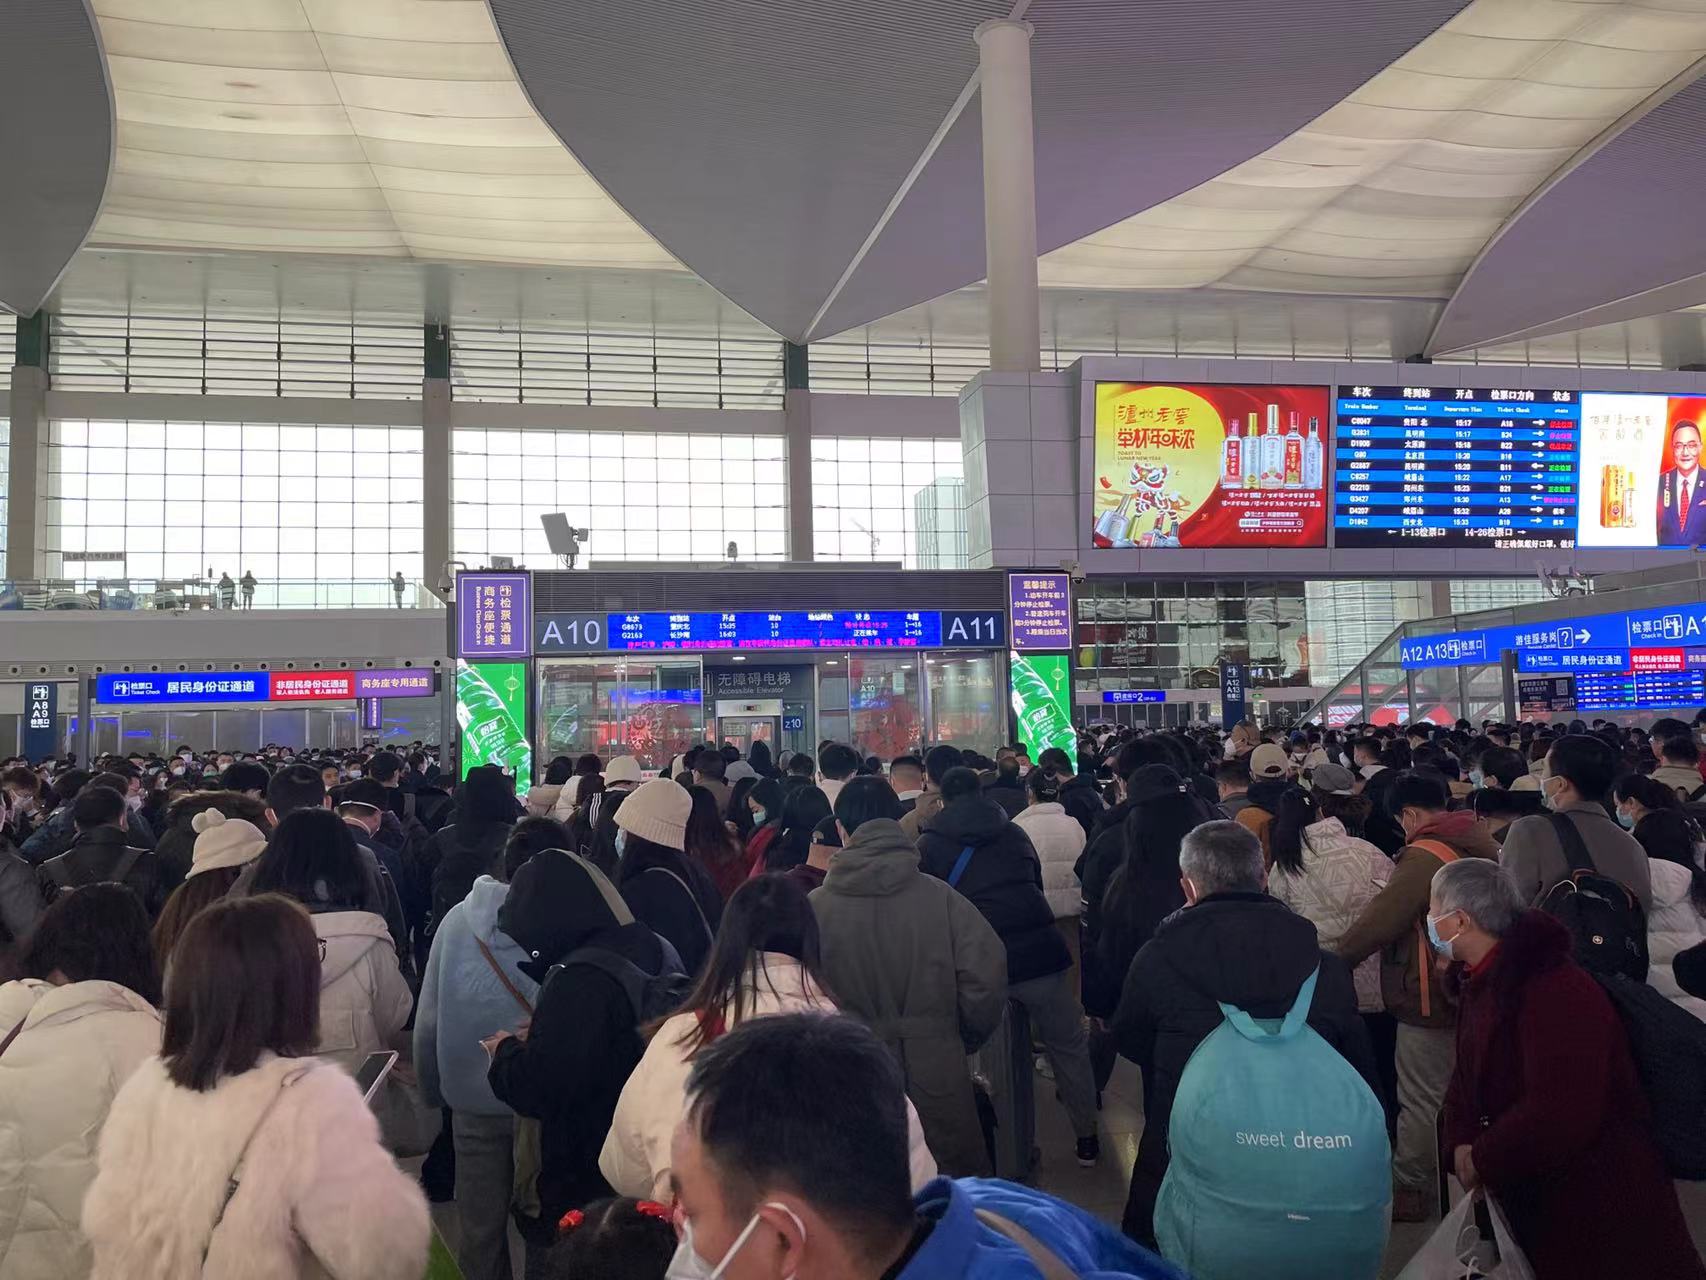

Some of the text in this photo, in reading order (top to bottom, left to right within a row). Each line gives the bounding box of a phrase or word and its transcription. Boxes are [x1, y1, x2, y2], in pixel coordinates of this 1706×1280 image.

[1352, 387, 1570, 401] 车次 终到站 开点 检票口方向 状态
[484, 586, 495, 646] 商务座便捷
[500, 597, 512, 645] 检票通道
[541, 620, 601, 645] A10
[948, 616, 995, 640] A11
[1632, 619, 1662, 634] 检票口
[1402, 640, 1483, 663] A12 A13 检票口
[1562, 655, 1622, 666] 居民身份证通道
[167, 678, 429, 695] 居民身份证通道 非居民身份证通道 商务座专用通道
[718, 672, 792, 687] 无障碍电梯
[33, 701, 48, 710] A8
[33, 710, 48, 718] A9
[1236, 1131, 1352, 1150] sweet dream
